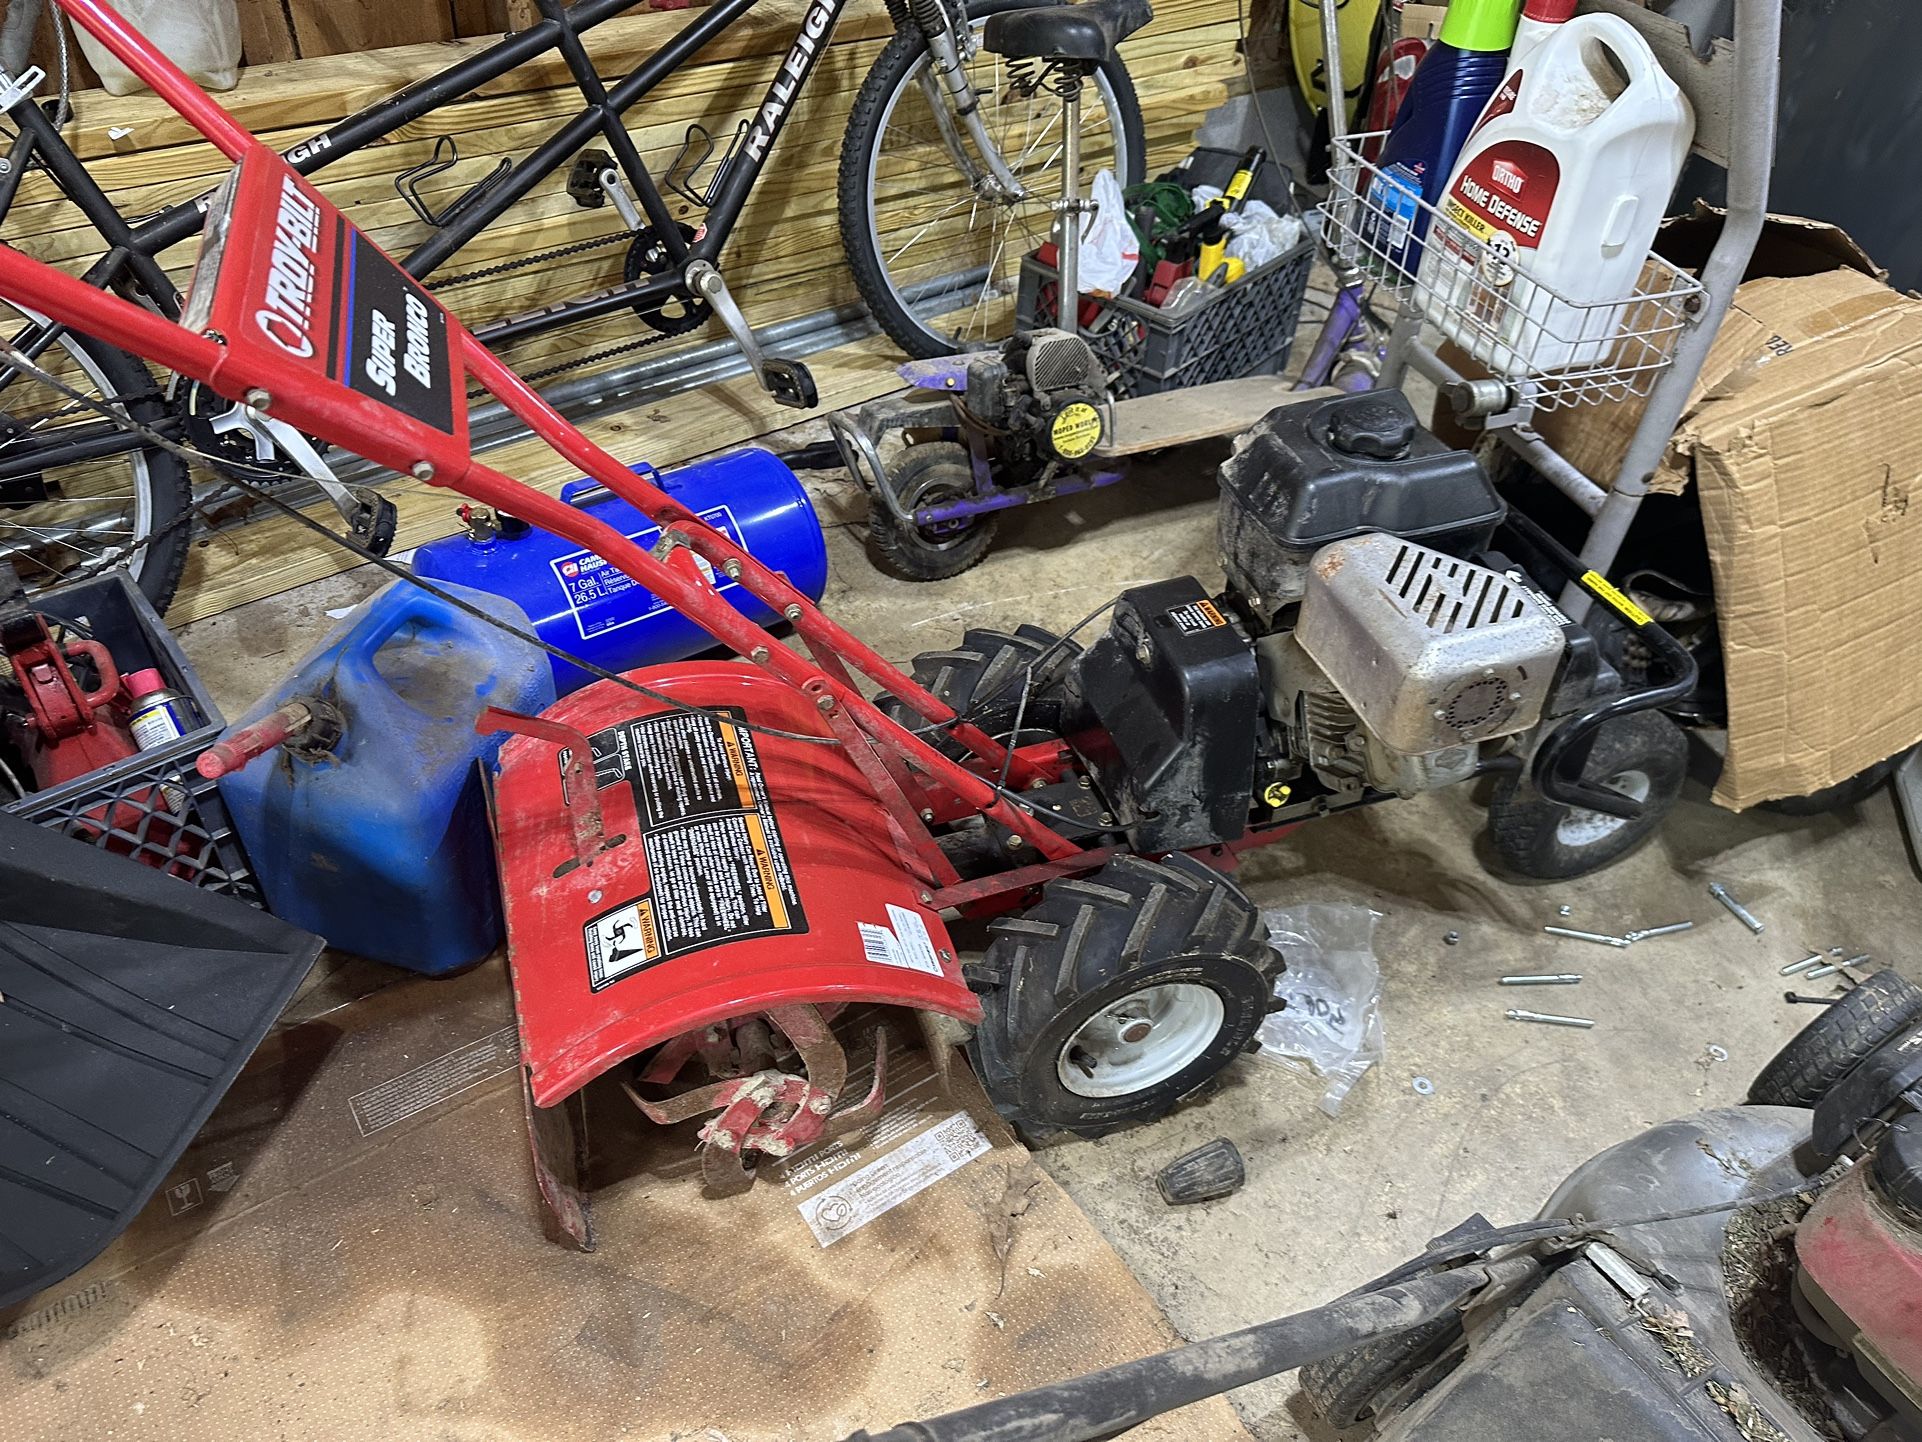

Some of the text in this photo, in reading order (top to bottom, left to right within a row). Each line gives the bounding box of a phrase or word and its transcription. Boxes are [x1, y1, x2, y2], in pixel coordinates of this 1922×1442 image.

[1491, 164, 1524, 194] ORTHO
[1460, 175, 1489, 208] HOME
[1487, 195, 1541, 237] DEFENSE
[1465, 212, 1485, 233] KILLER
[366, 309, 396, 396] SUPER
[403, 293, 431, 389] BRONCO
[568, 576, 599, 592] 7 Gal.
[574, 589, 597, 604] 26.5
[728, 747, 743, 776] WARNING
[737, 726, 759, 773] MPORTANT:
[758, 856, 776, 890] WARNING
[641, 915, 655, 954] WARNING
[819, 1140, 843, 1157] PORTS
[789, 1167, 816, 1185] PORTS
[795, 1171, 828, 1194] PUERTOS
